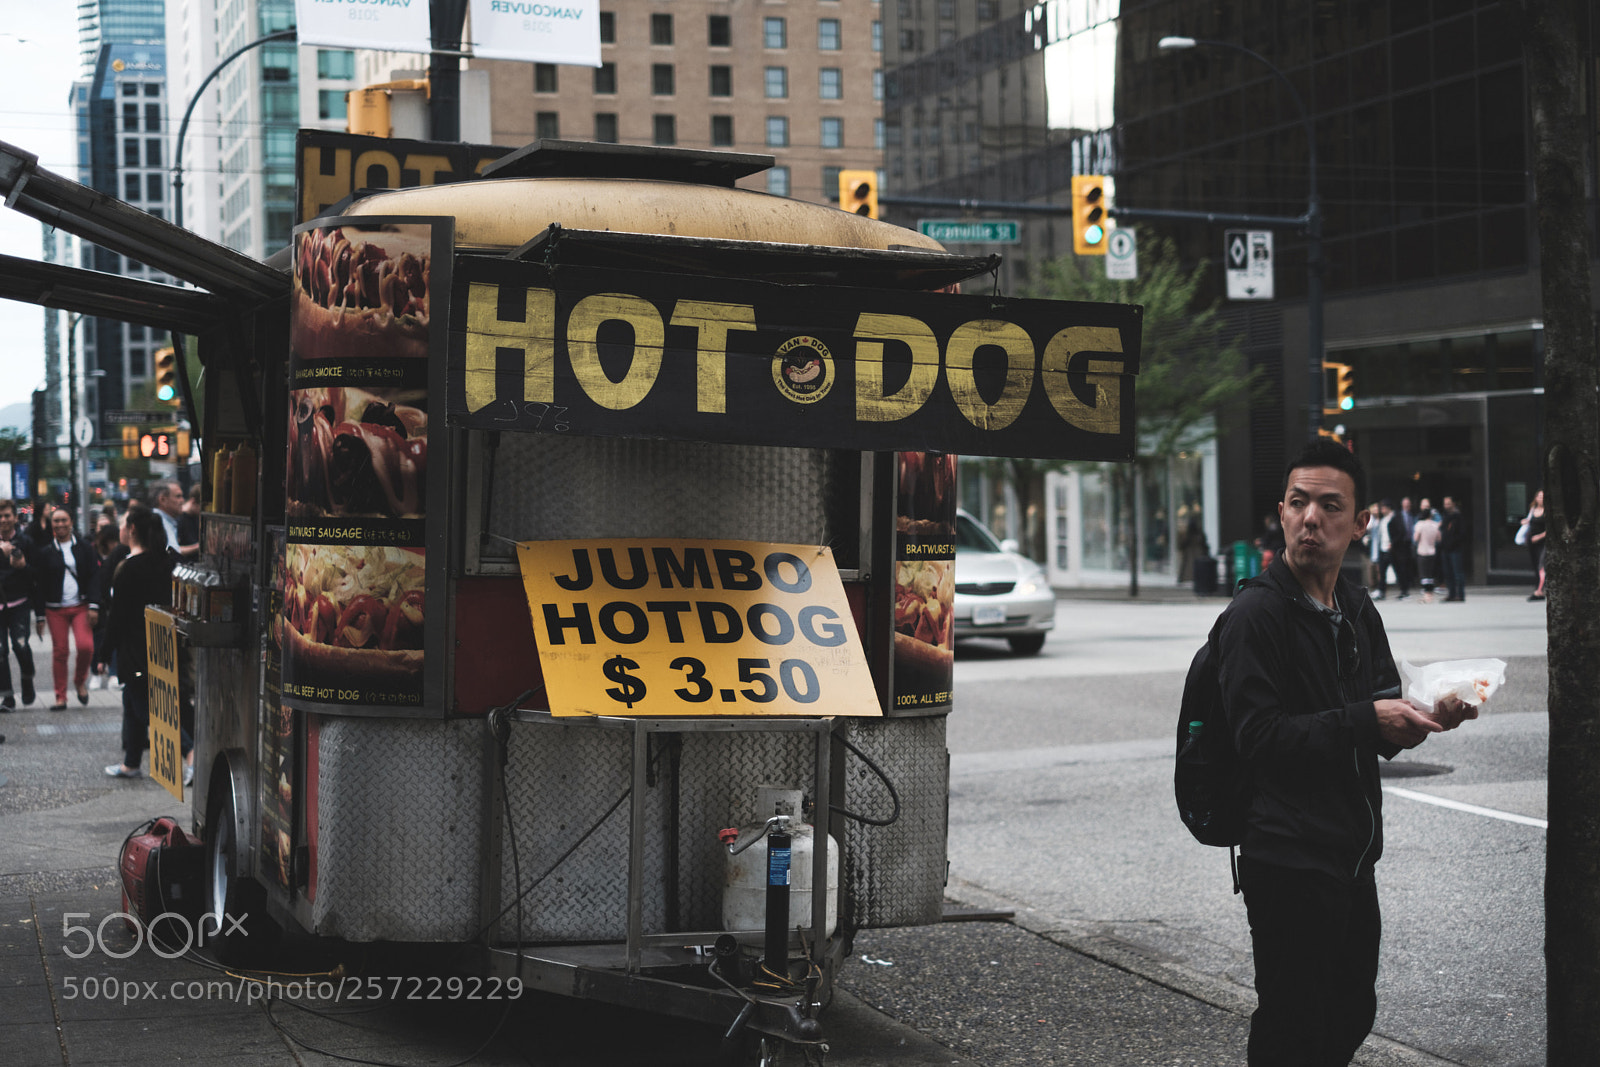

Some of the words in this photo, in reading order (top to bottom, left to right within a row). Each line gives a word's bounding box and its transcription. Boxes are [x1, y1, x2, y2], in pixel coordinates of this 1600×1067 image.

[927, 223, 992, 240] Granville
[465, 281, 757, 415] HOT
[852, 312, 1124, 434] DOG
[781, 338, 800, 353] VAN
[811, 339, 829, 357] DOG
[315, 366, 343, 377] SMOKIE
[318, 527, 363, 539] SAUSAGE
[905, 544, 950, 555] BRATWURST
[554, 547, 813, 594] JUMBO
[542, 601, 848, 648] HOTDOG
[149, 621, 175, 673] JUMBO
[293, 685, 301, 695] ALL
[301, 685, 315, 697] BEEF
[316, 688, 335, 699] HOT
[338, 689, 360, 700] DOG
[602, 654, 647, 709] $
[669, 657, 821, 704] 3.50
[897, 694, 918, 705] 100%
[920, 693, 933, 704] ALL
[935, 691, 948, 703] BEEF
[149, 673, 179, 731] HOTDOG
[154, 728, 159, 773] $
[160, 733, 176, 786] 3.50
